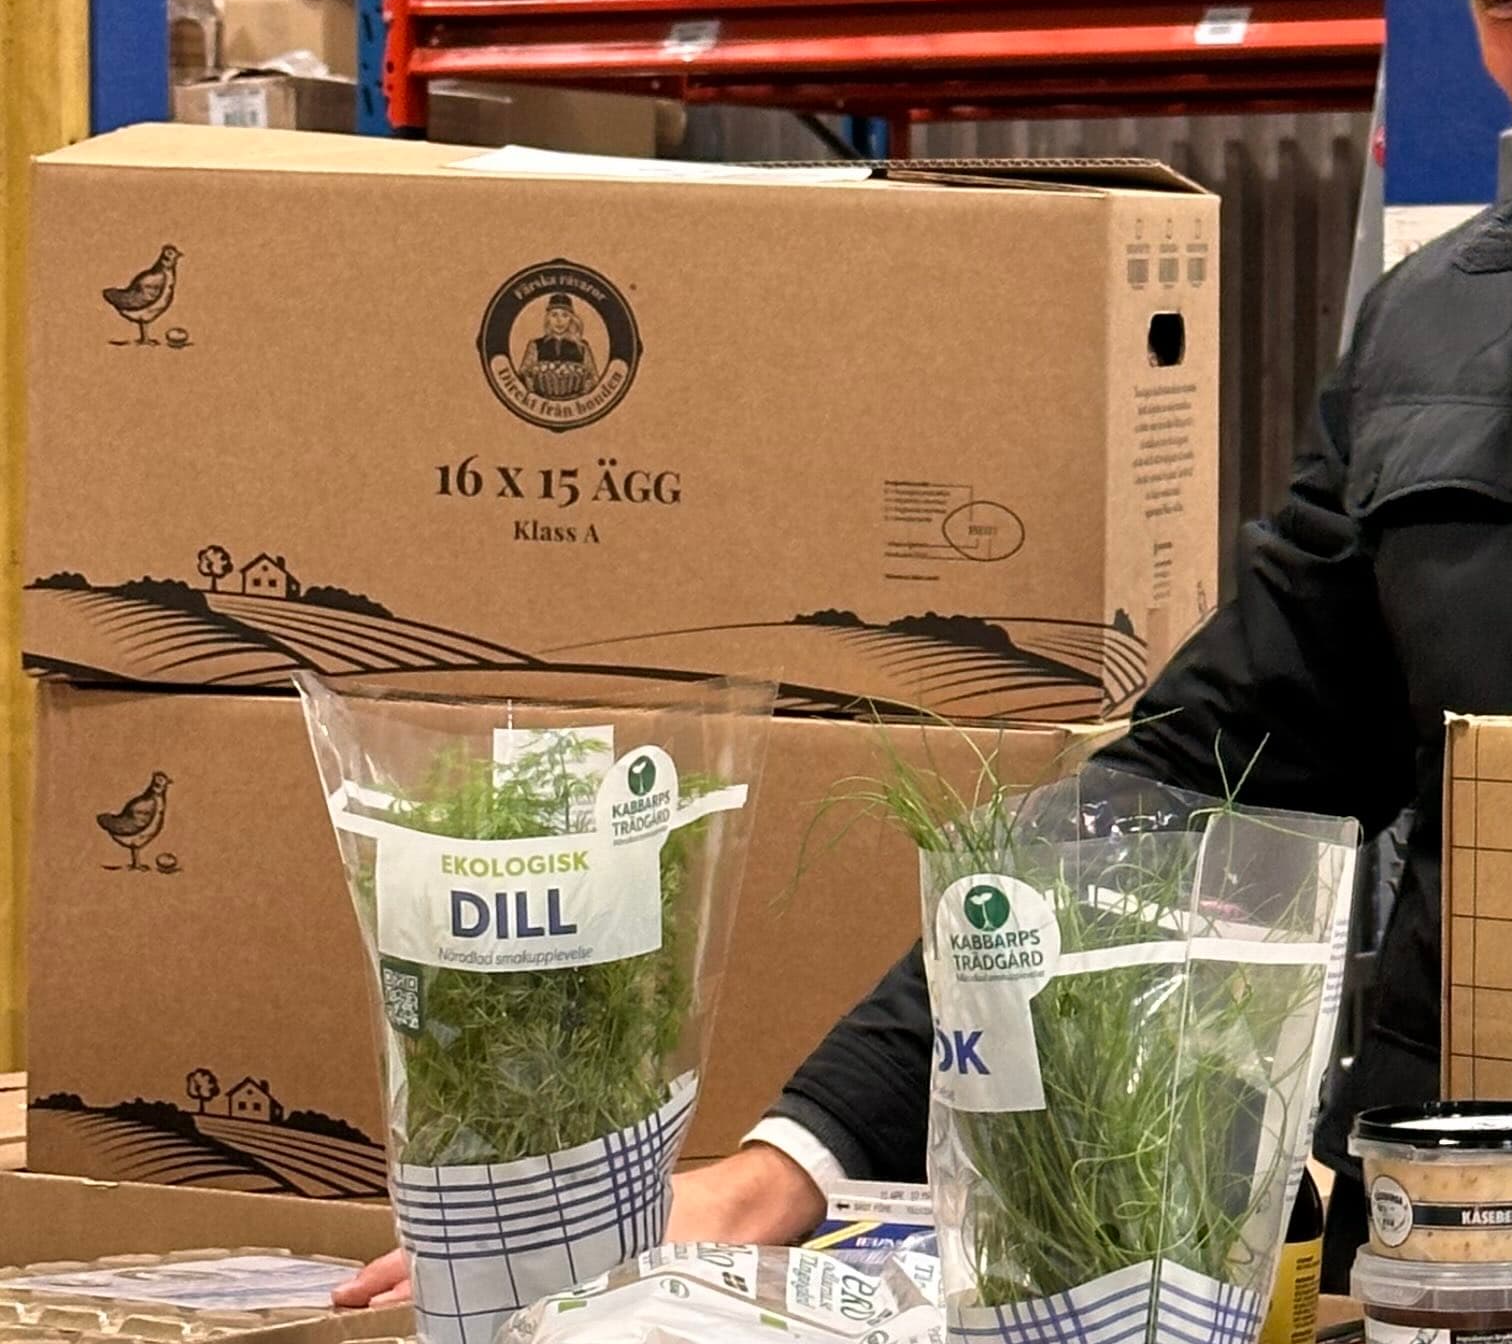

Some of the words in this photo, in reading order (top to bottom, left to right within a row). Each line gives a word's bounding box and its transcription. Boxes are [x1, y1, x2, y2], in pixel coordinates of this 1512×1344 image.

[498, 366, 537, 411] Direkt
[540, 402, 573, 418] från
[576, 370, 622, 414] bonden
[435, 454, 484, 497] 16
[537, 468, 580, 508] 15
[591, 457, 682, 505] ÄGG
[513, 520, 577, 542] Klass
[583, 523, 601, 544] A
[612, 789, 671, 819] KABBARPS
[441, 850, 590, 878] EKOLOGISK
[451, 888, 577, 940] DILL
[950, 929, 1041, 951] KABBARPS
[953, 950, 1045, 972] TRÄDGÅRD
